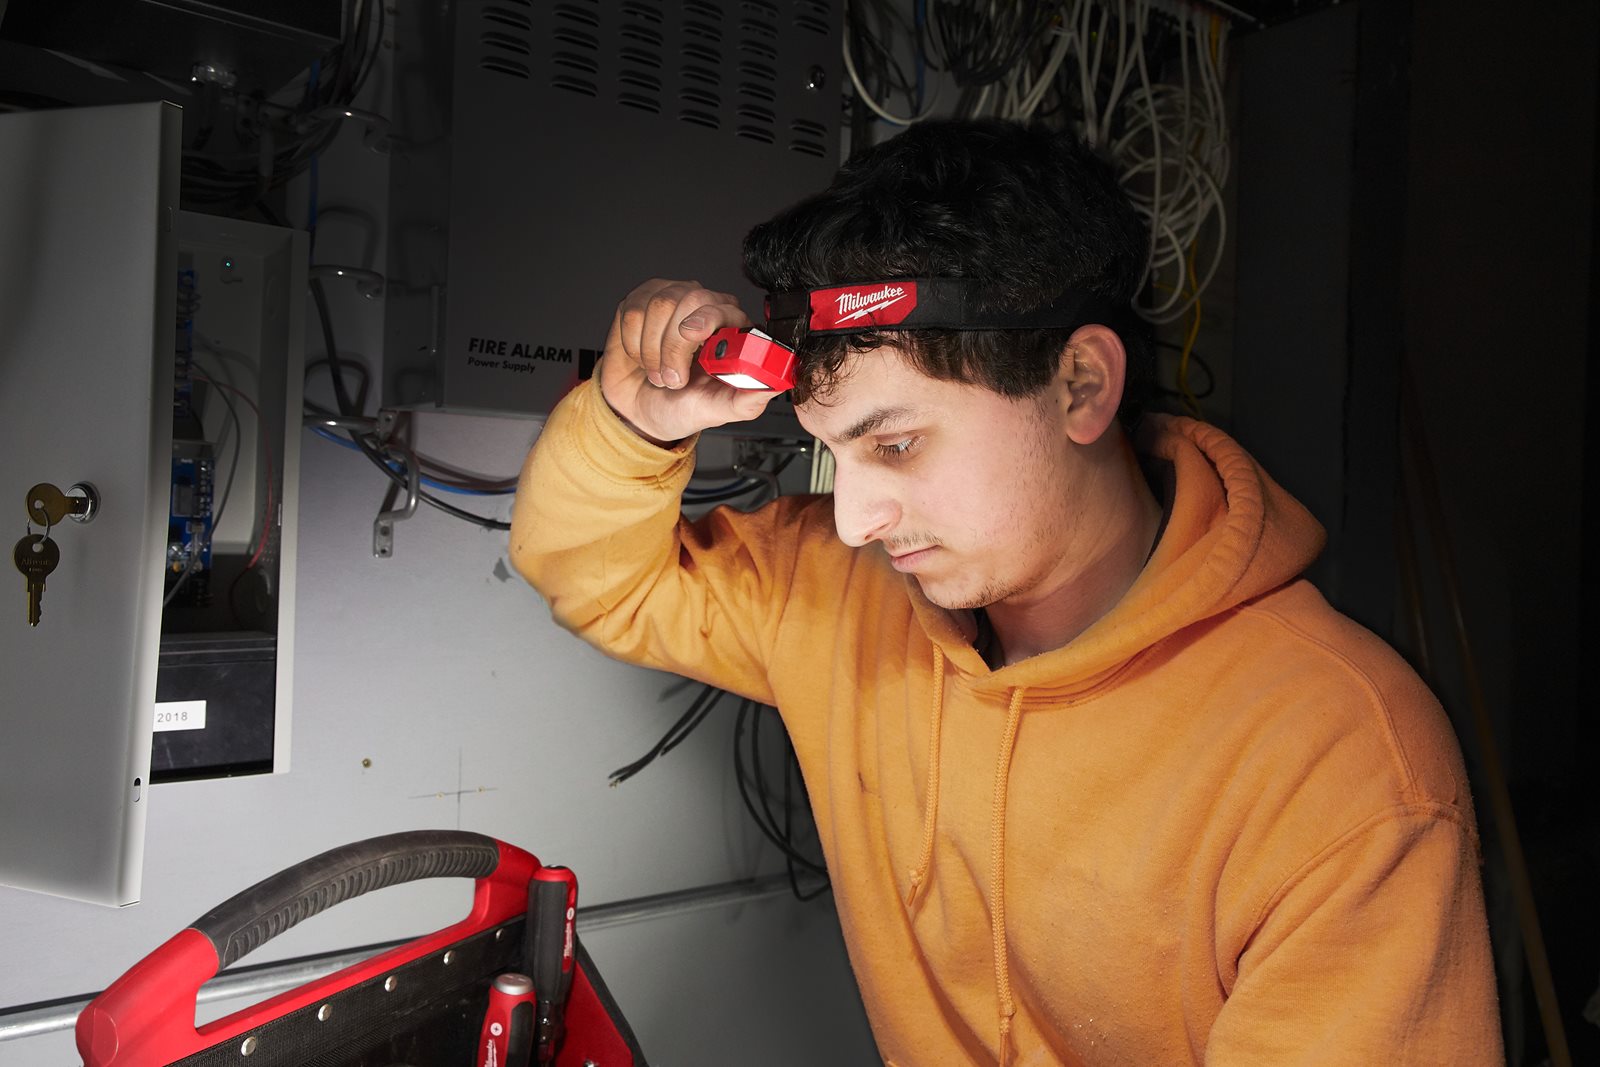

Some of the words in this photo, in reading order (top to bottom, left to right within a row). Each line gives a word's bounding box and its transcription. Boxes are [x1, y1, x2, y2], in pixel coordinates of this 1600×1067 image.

[835, 286, 905, 315] Milwaukee
[468, 337, 508, 356] FIRE
[511, 343, 573, 363] ALARM
[467, 356, 500, 369] Power
[502, 360, 536, 374] Supply
[157, 711, 188, 723] 2018
